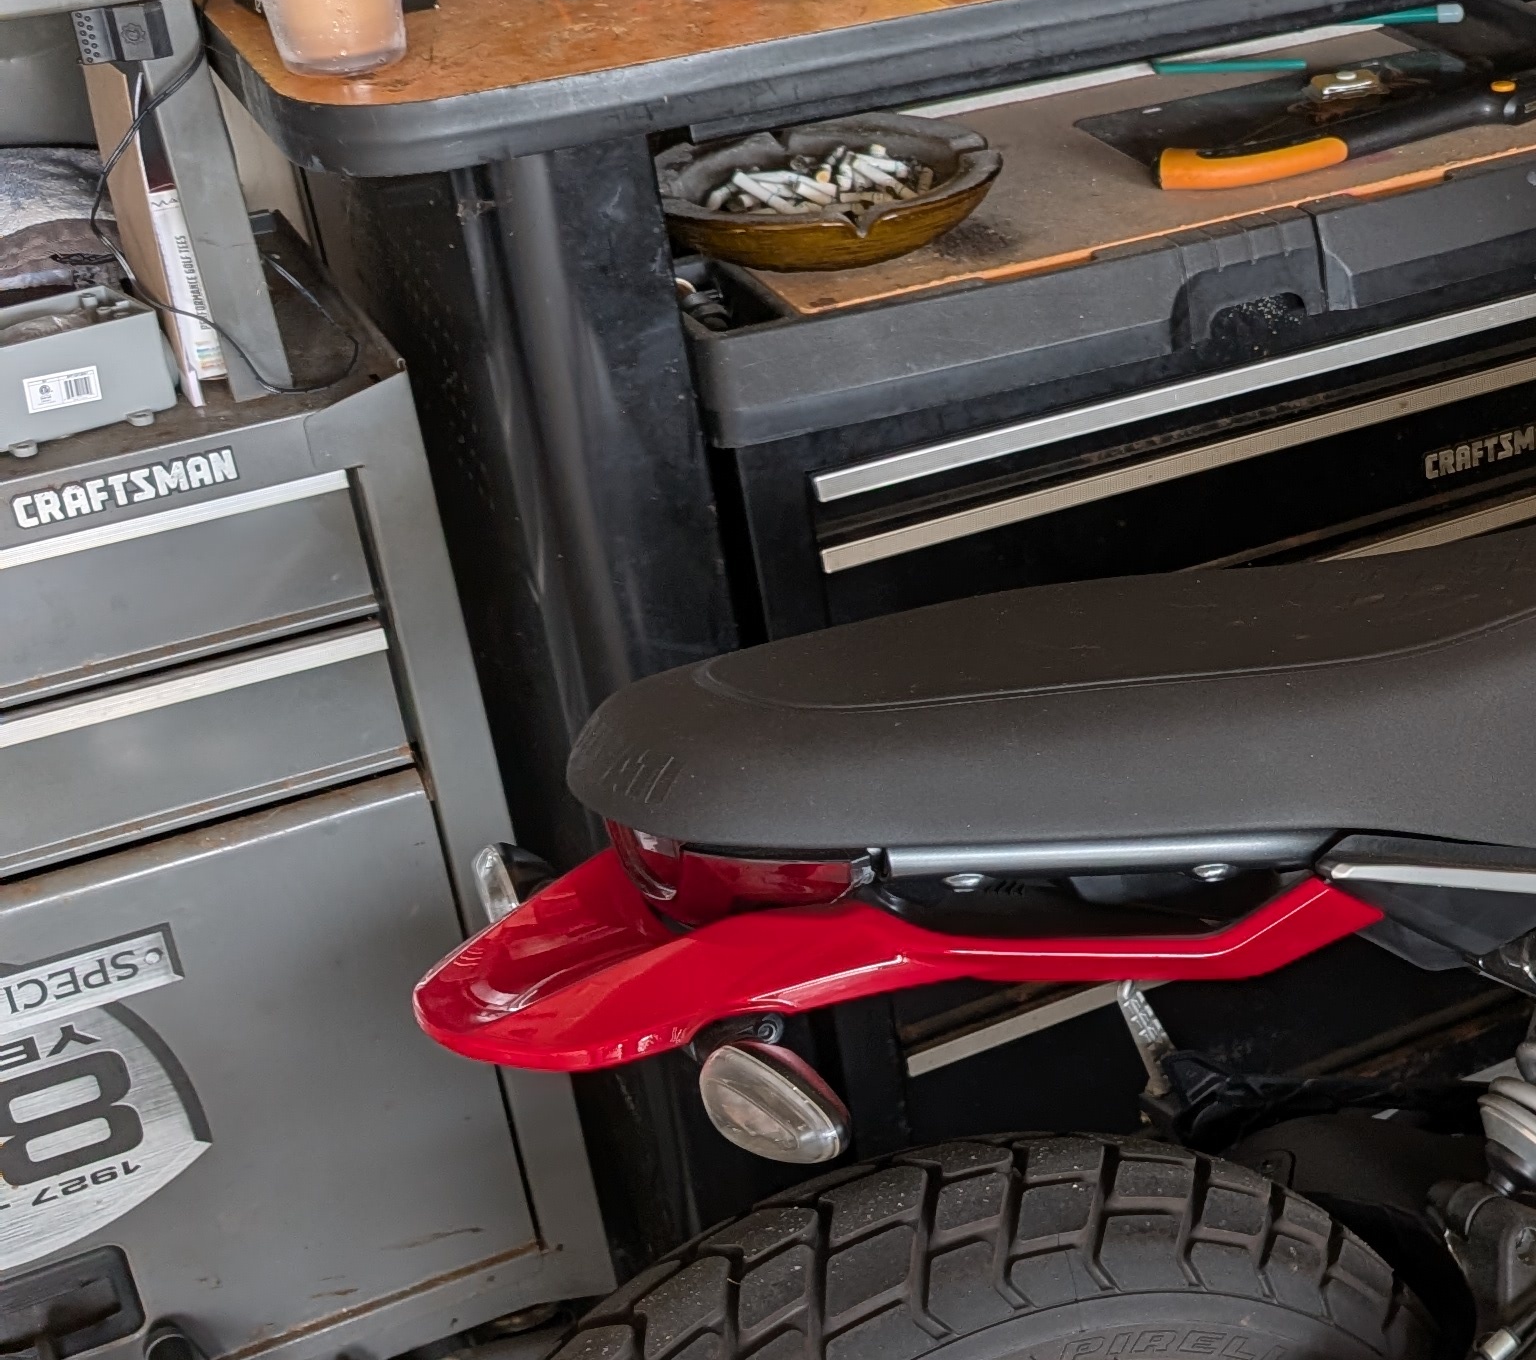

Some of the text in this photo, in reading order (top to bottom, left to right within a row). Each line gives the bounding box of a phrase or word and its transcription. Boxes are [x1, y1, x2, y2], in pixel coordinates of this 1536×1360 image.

[174, 234, 191, 254] TEES
[181, 255, 196, 275] GOLF
[12, 449, 239, 529] CRAFTSMAN
